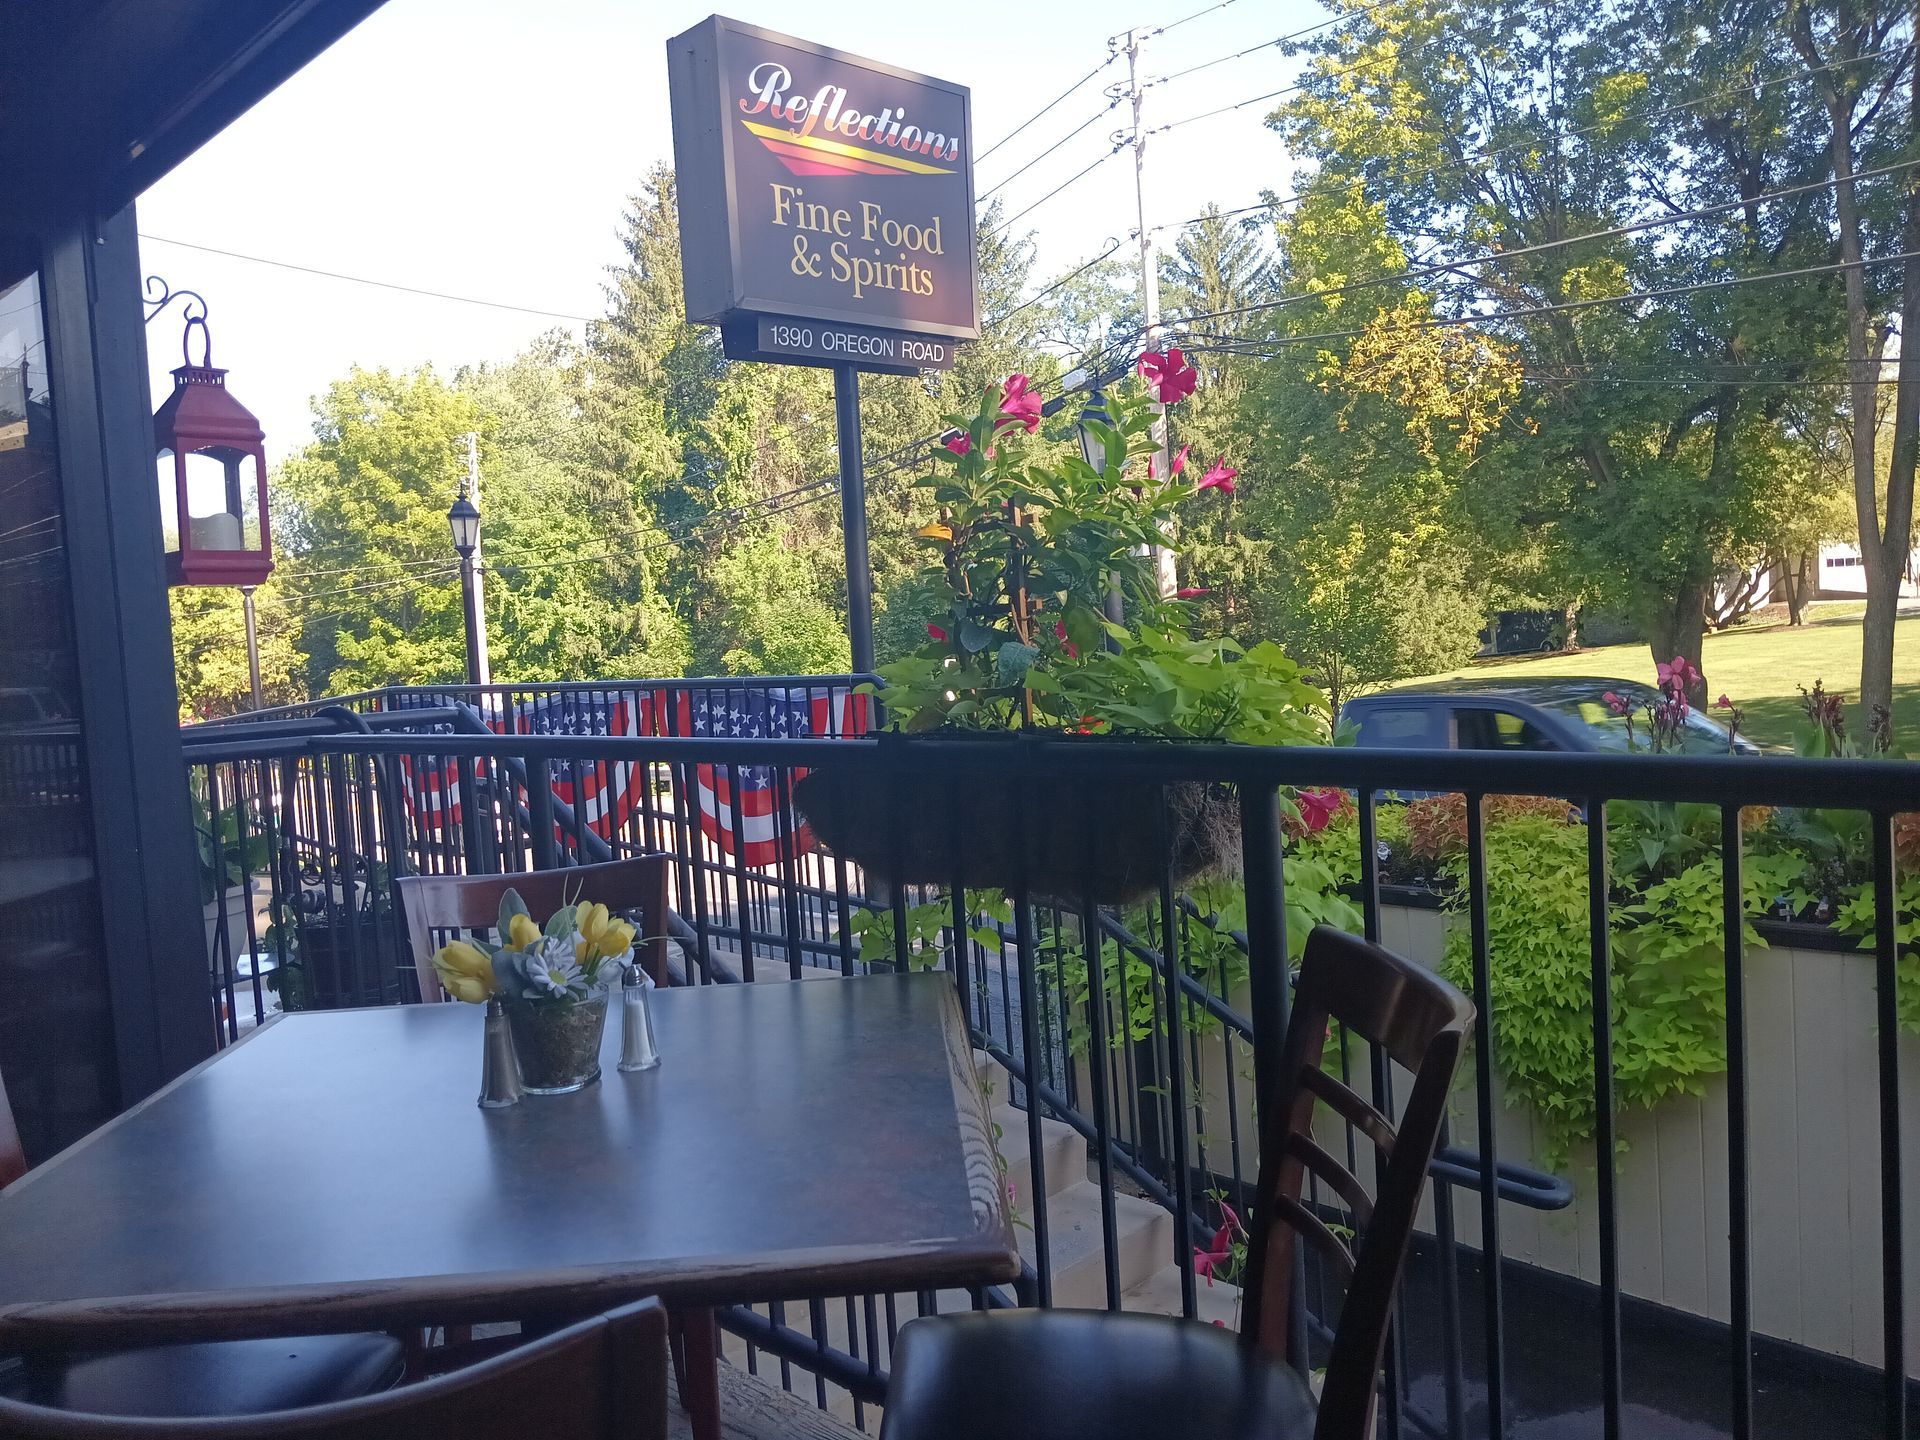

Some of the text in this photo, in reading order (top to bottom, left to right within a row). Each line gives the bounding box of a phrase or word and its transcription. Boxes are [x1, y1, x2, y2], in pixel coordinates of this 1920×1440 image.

[739, 62, 959, 162] Reflections
[769, 183, 945, 255] Fine Food
[791, 235, 934, 299] & Spirits
[770, 325, 944, 363] 1390 OREGON ROAD
